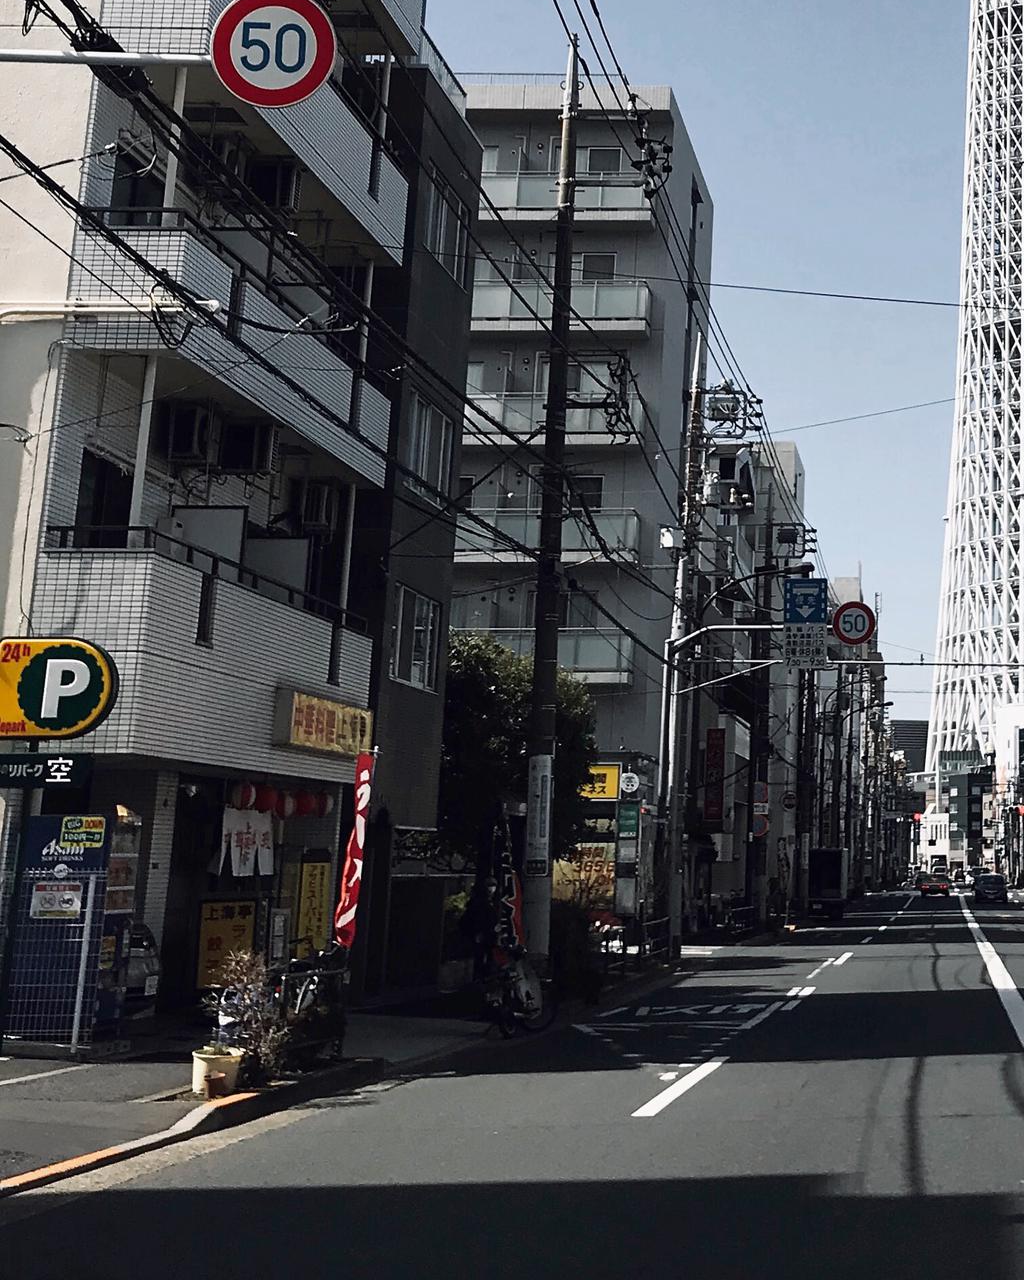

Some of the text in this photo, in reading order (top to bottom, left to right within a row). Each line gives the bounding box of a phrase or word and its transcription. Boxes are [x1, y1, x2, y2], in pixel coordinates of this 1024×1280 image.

[241, 21, 307, 73] 50
[842, 614, 865, 632] 50
[2, 643, 30, 663] 24h
[41, 658, 91, 719] P
[0, 720, 26, 733] epark
[45, 757, 73, 783] 空
